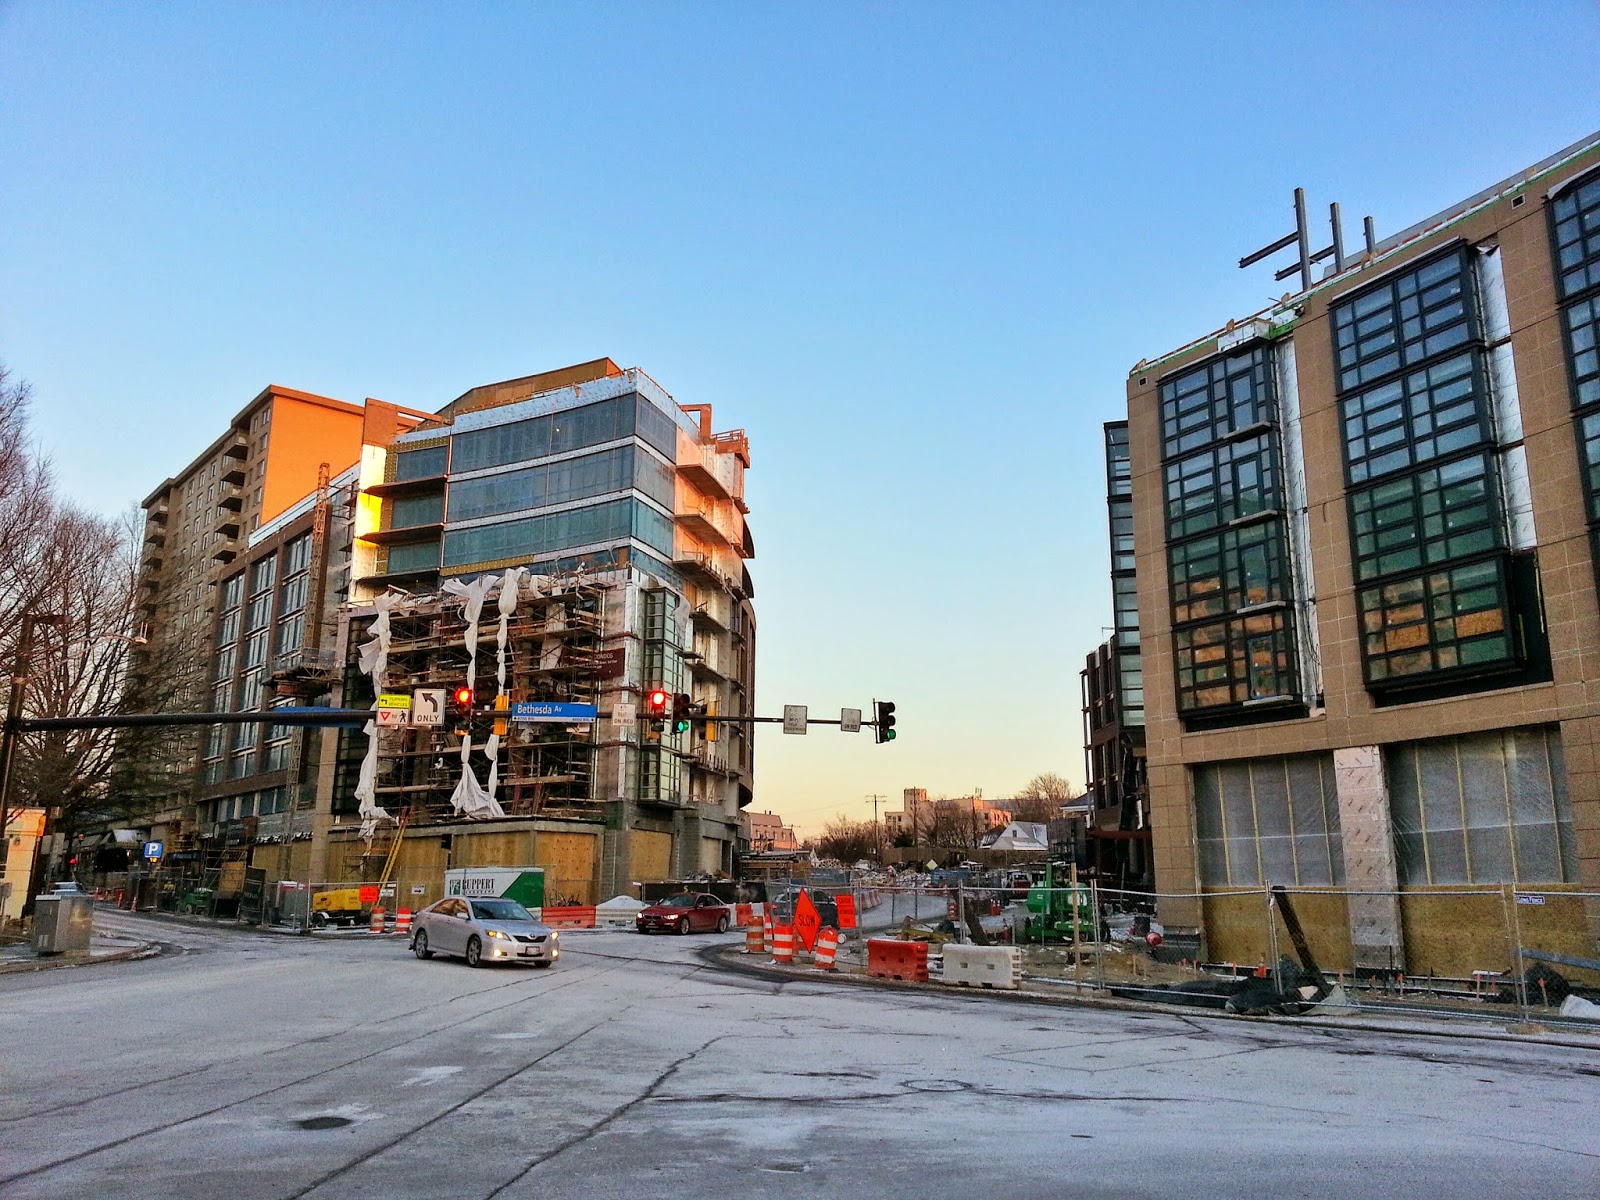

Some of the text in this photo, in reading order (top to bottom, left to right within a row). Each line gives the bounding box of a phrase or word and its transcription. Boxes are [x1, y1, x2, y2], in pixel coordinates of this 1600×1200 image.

[517, 704, 563, 714] Bethesda Av
[417, 714, 440, 722] ONLY
[148, 843, 159, 855] P
[462, 878, 495, 890] RUPPERT
[798, 914, 816, 927] SLOW
